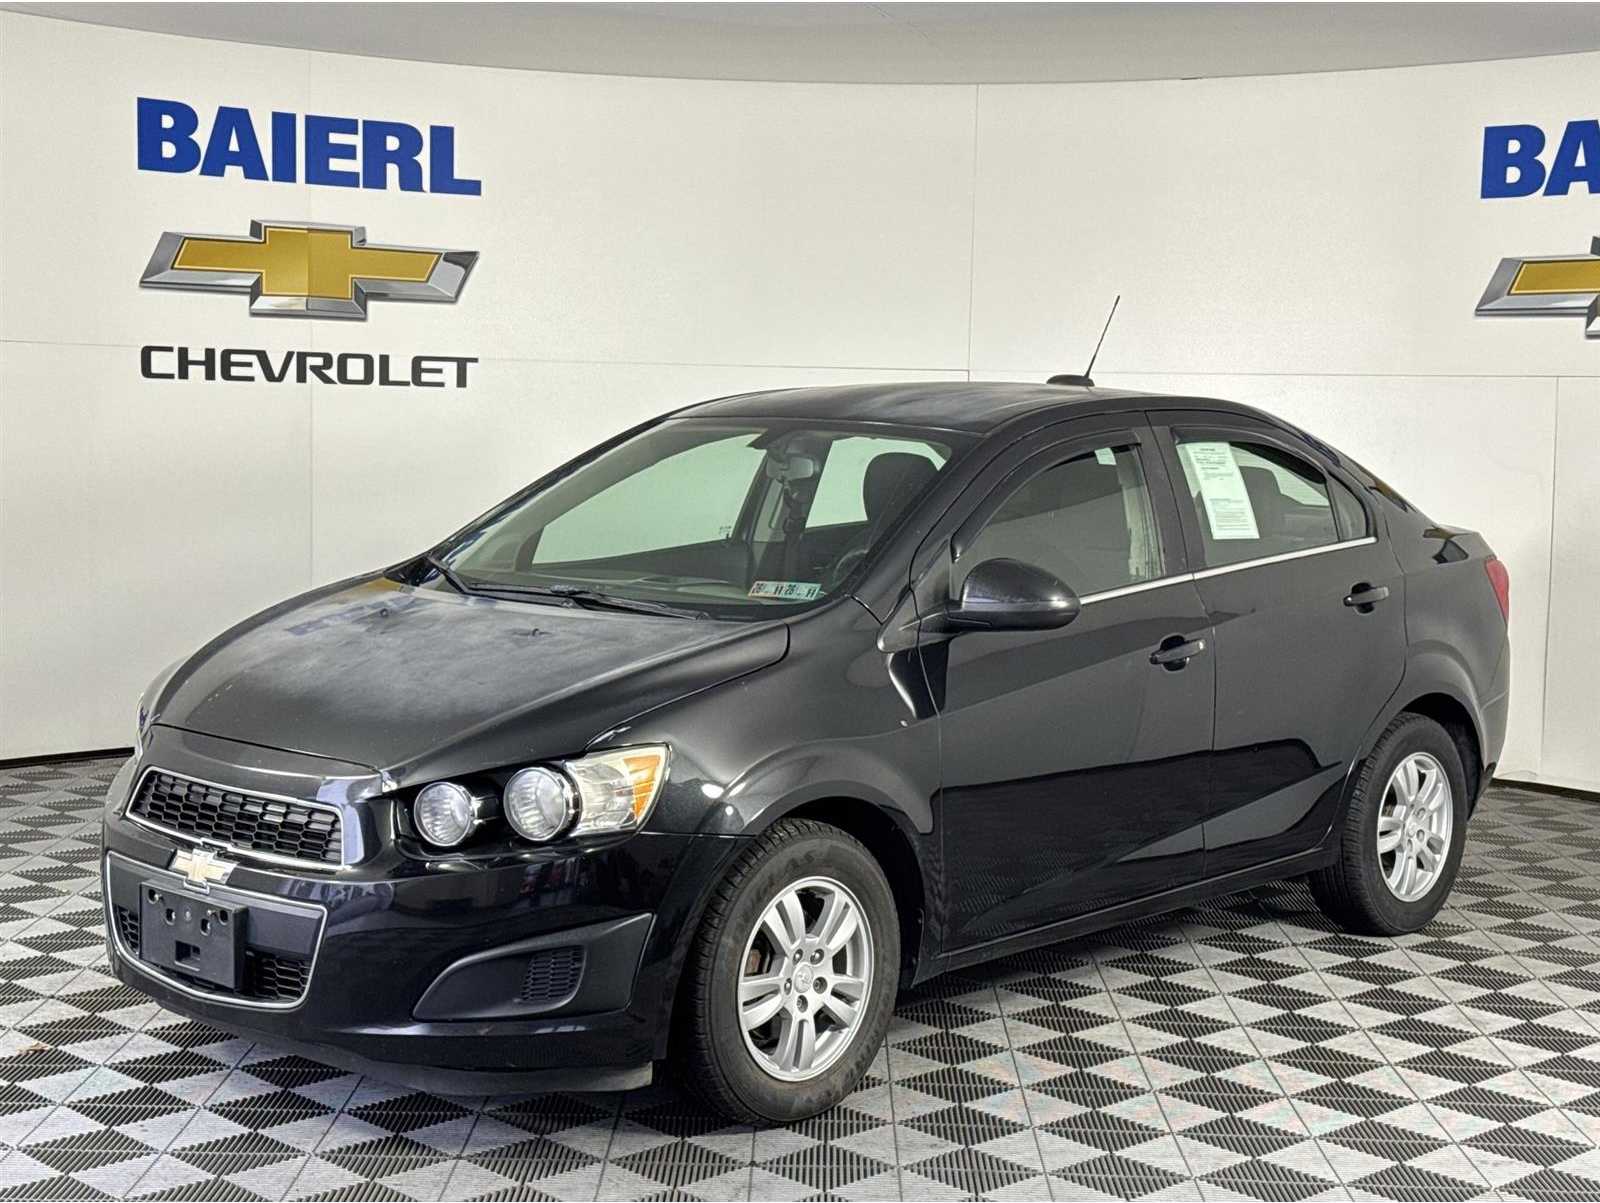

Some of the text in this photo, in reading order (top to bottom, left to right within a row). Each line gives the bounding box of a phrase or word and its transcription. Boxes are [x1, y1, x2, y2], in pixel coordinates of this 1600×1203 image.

[137, 97, 482, 196] BAIERL
[1480, 119, 1600, 199] BA
[140, 345, 479, 388] CHEVROLET
